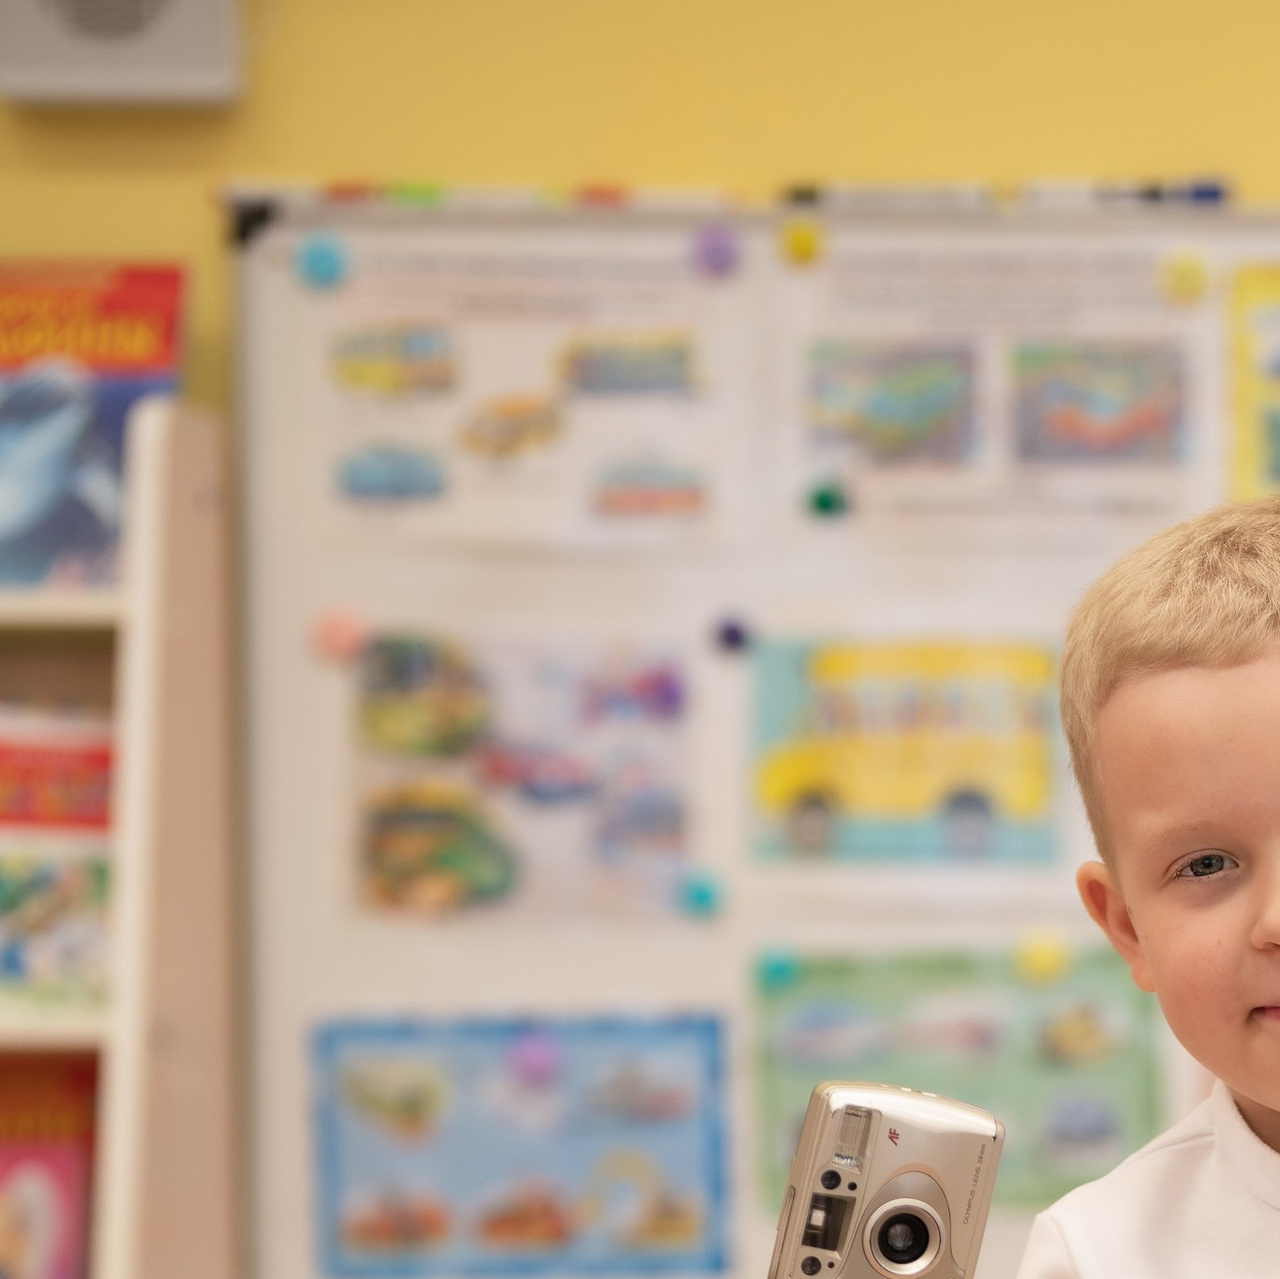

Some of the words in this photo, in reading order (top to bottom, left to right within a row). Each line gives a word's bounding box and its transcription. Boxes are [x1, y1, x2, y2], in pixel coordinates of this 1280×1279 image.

[887, 1127, 900, 1147] AF
[962, 1189, 976, 1225] OLYMPUS
[971, 1166, 982, 1188] LENS
